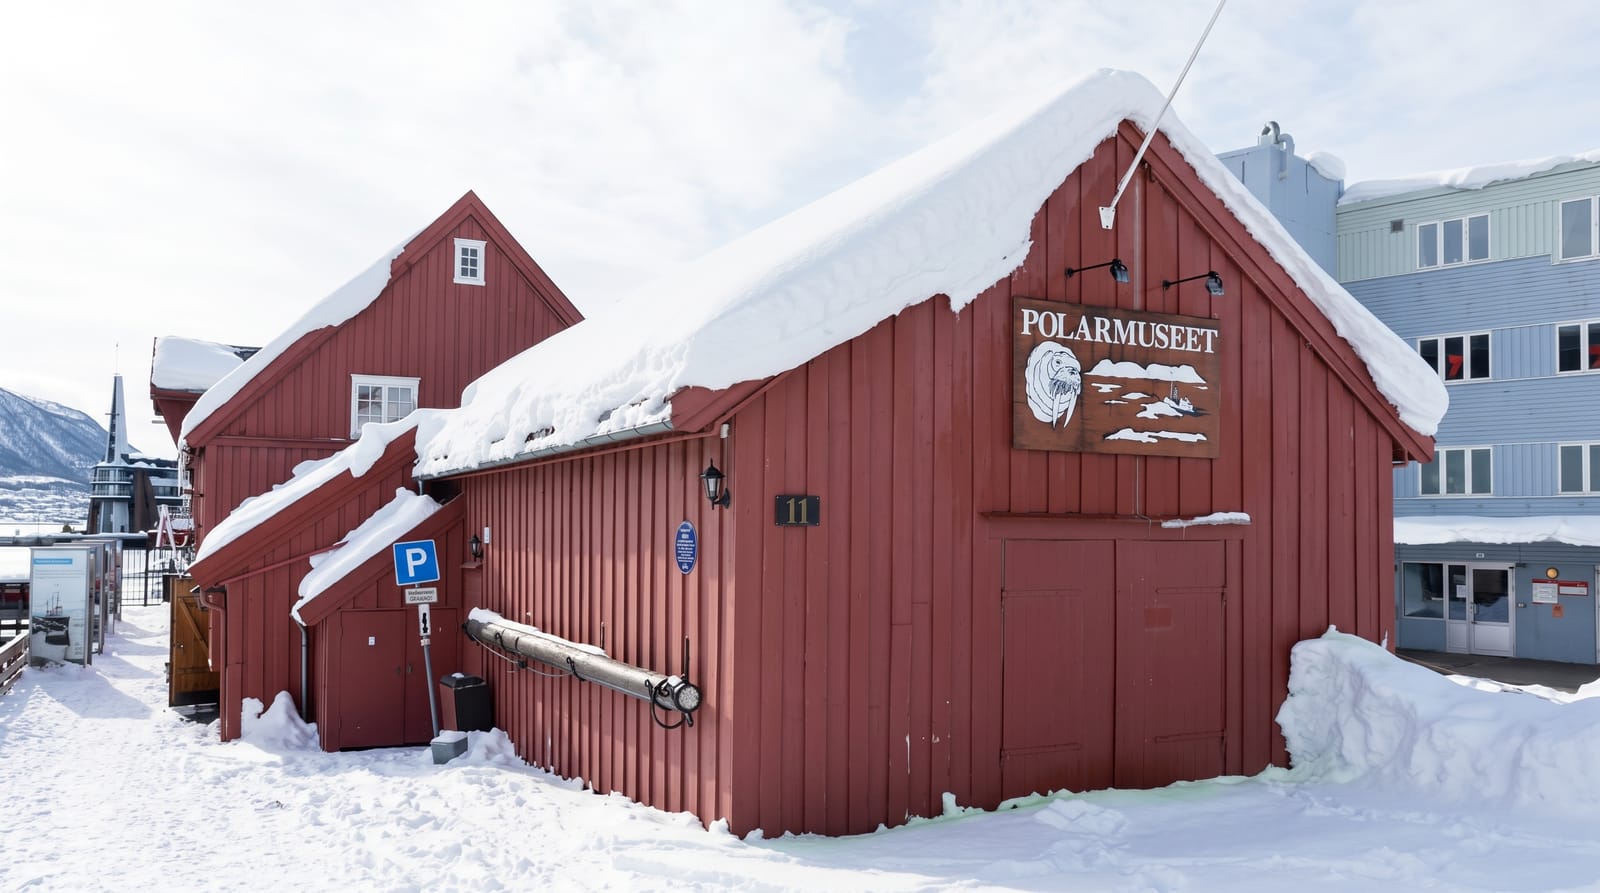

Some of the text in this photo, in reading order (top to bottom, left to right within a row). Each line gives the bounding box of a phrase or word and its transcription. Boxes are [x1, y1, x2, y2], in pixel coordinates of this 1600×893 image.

[1021, 308, 1218, 353] POLARMUSEET
[786, 497, 808, 523] 11
[405, 547, 427, 577] P
